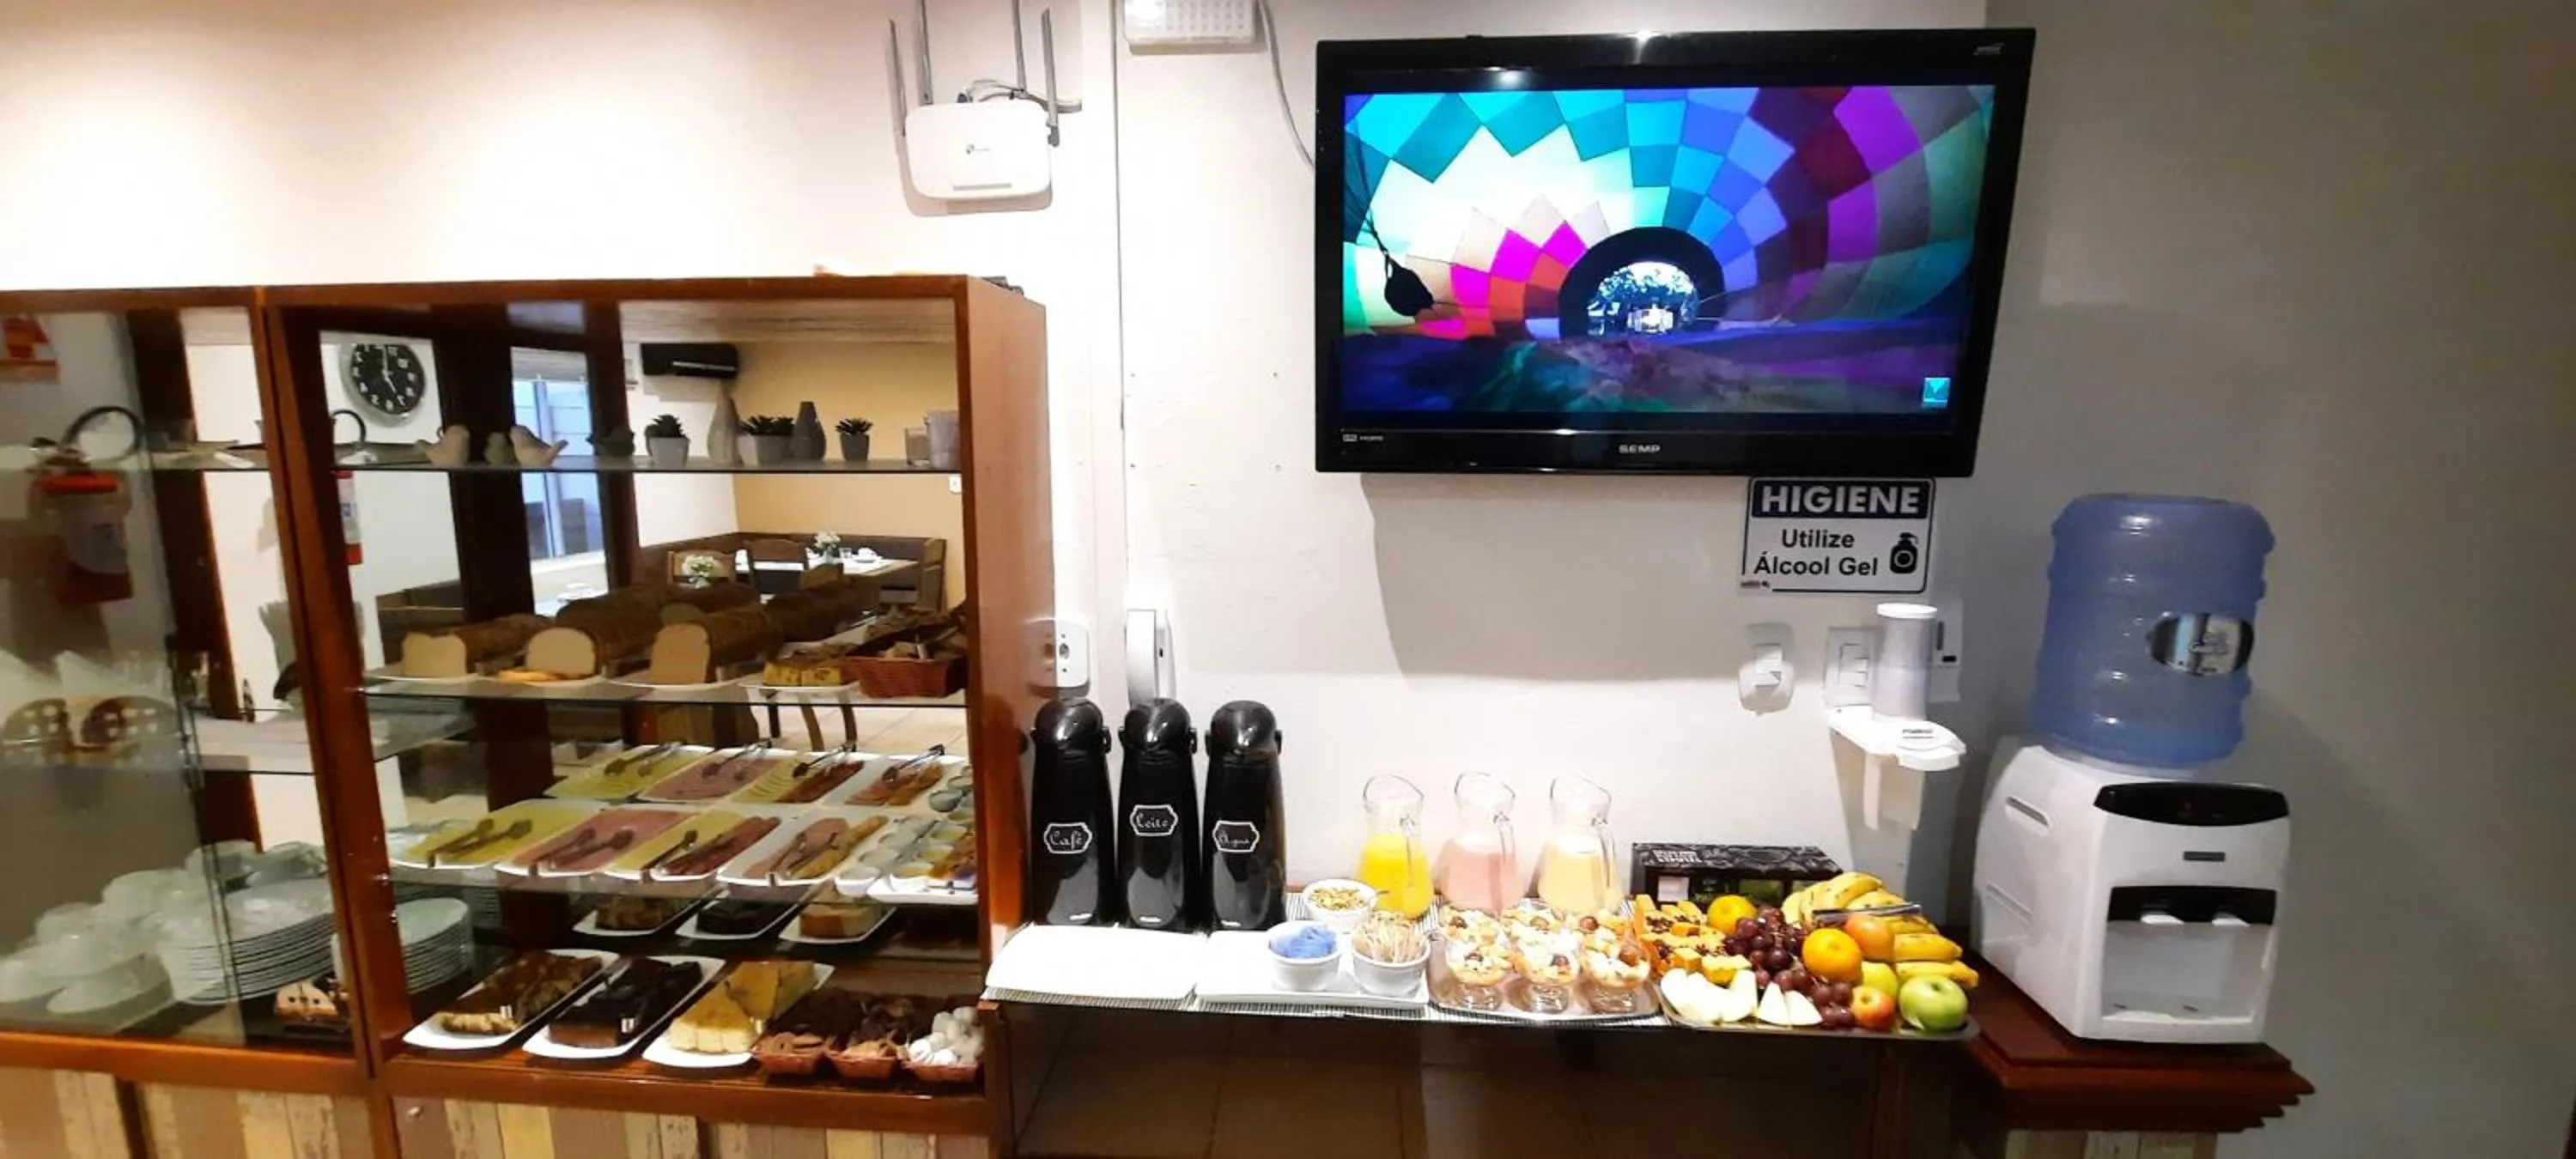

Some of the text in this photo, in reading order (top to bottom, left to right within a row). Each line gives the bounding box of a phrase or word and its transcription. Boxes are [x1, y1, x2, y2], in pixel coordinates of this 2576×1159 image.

[1619, 444, 1661, 454] SEMP
[1761, 485, 1921, 513] HIGIENE
[1782, 528, 1855, 549] Utilize
[1753, 550, 1878, 576] Álcool Gel
[1136, 811, 1169, 828] Leite
[1048, 828, 1083, 851] Café
